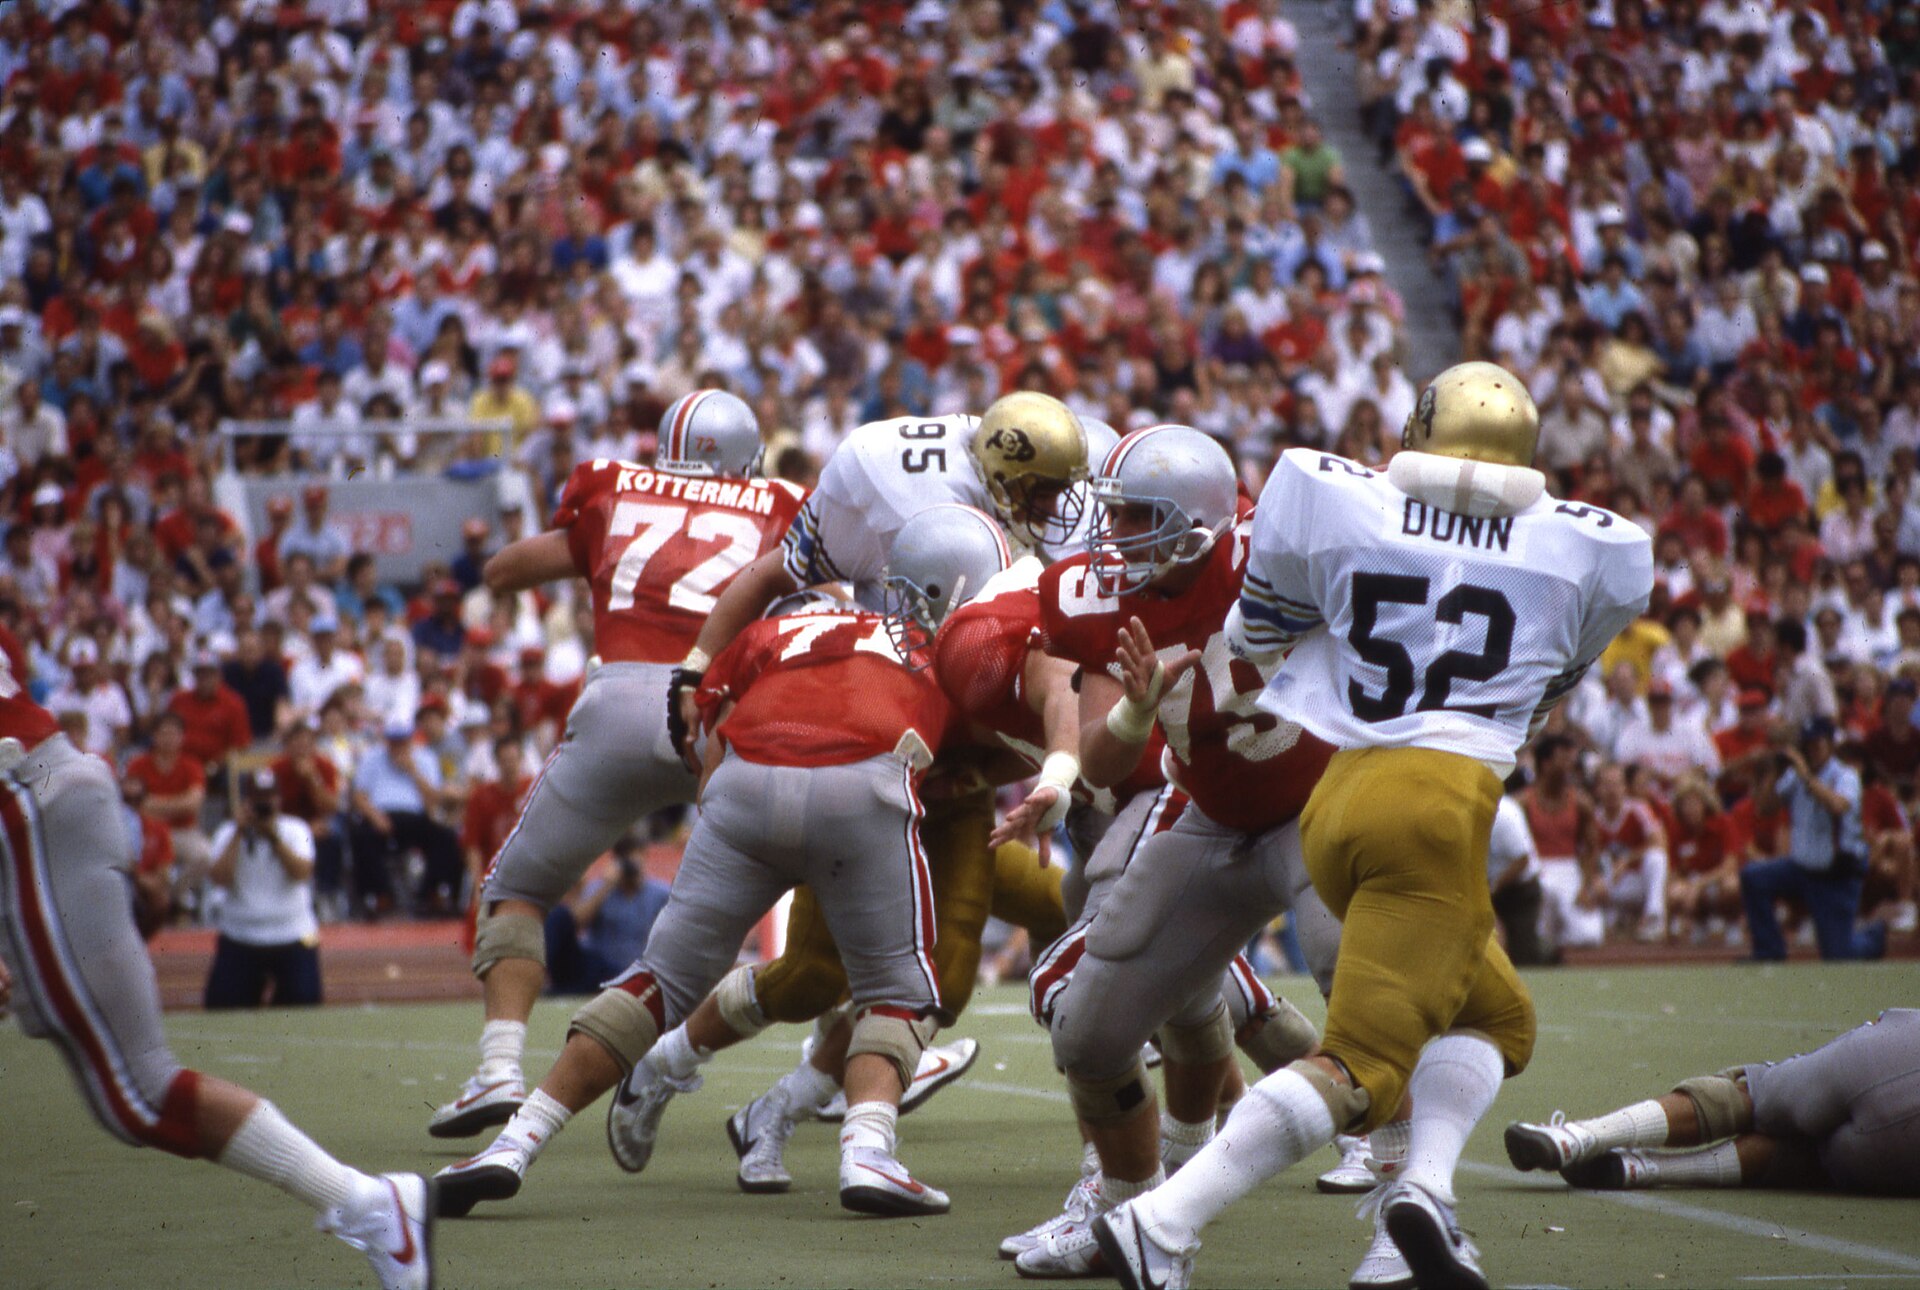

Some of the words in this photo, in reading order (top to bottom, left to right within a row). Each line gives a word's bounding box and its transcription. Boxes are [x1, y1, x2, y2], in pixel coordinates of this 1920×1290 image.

[695, 435, 718, 453] 72
[899, 423, 947, 473] 95
[615, 469, 775, 515] KOTTERMAN
[1402, 496, 1514, 552] DUNN
[608, 501, 762, 614] 72
[1347, 571, 1517, 723] 52
